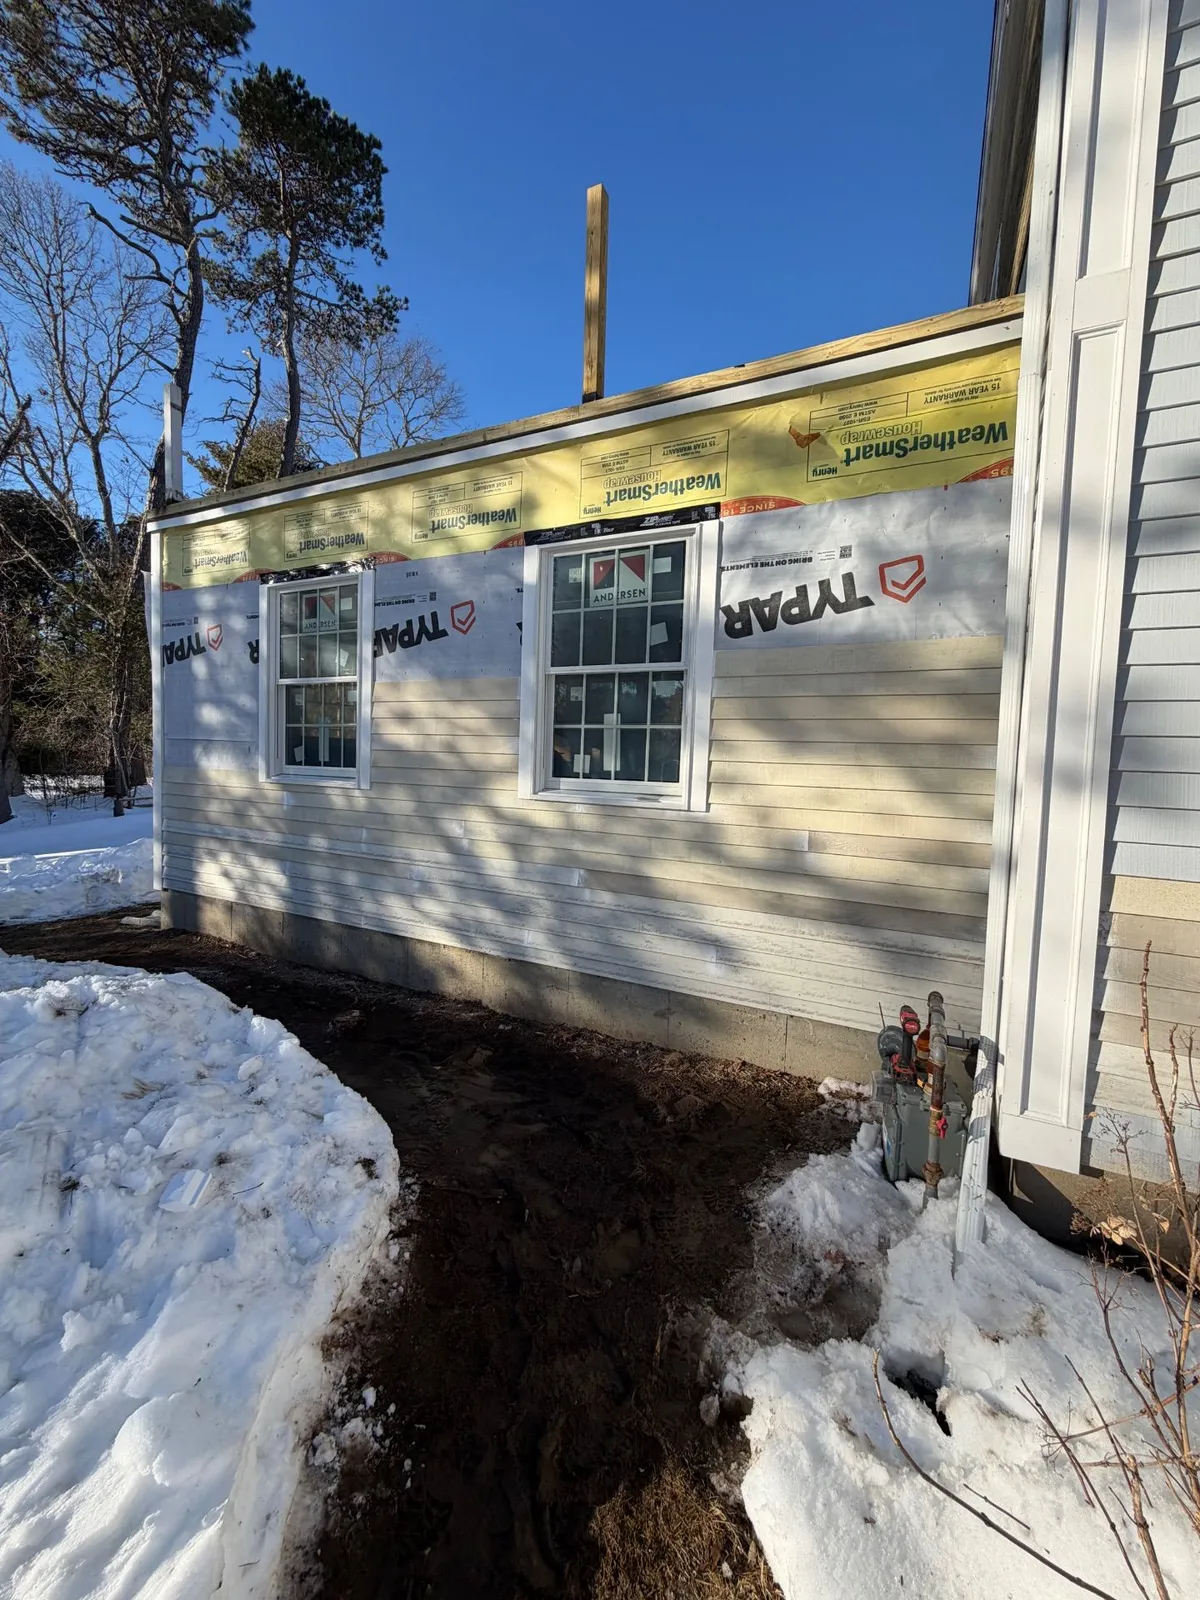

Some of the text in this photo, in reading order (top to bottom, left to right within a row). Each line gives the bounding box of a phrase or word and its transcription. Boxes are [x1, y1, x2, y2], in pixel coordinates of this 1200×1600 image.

[924, 383, 1001, 405] 15 YEAR WARRANTY
[838, 400, 878, 412] www.henry.com
[859, 409, 876, 418] ASTM
[840, 420, 923, 445] Housewrap
[843, 421, 1008, 467] WeatherSmart
[603, 469, 662, 489] Housewrap
[812, 466, 838, 477] Henry
[605, 472, 721, 506] WeatherSmart
[429, 503, 474, 518] Housewrap
[740, 501, 776, 514] SINCE
[430, 507, 517, 533] WeatherSmart
[299, 532, 365, 554] WeatherSmart
[760, 560, 776, 568] THE
[778, 559, 787, 567] ON
[788, 556, 813, 565] BRING
[720, 571, 875, 639] TYPAR
[304, 619, 336, 629] ANDRSEN
[161, 631, 207, 668] TYPA
